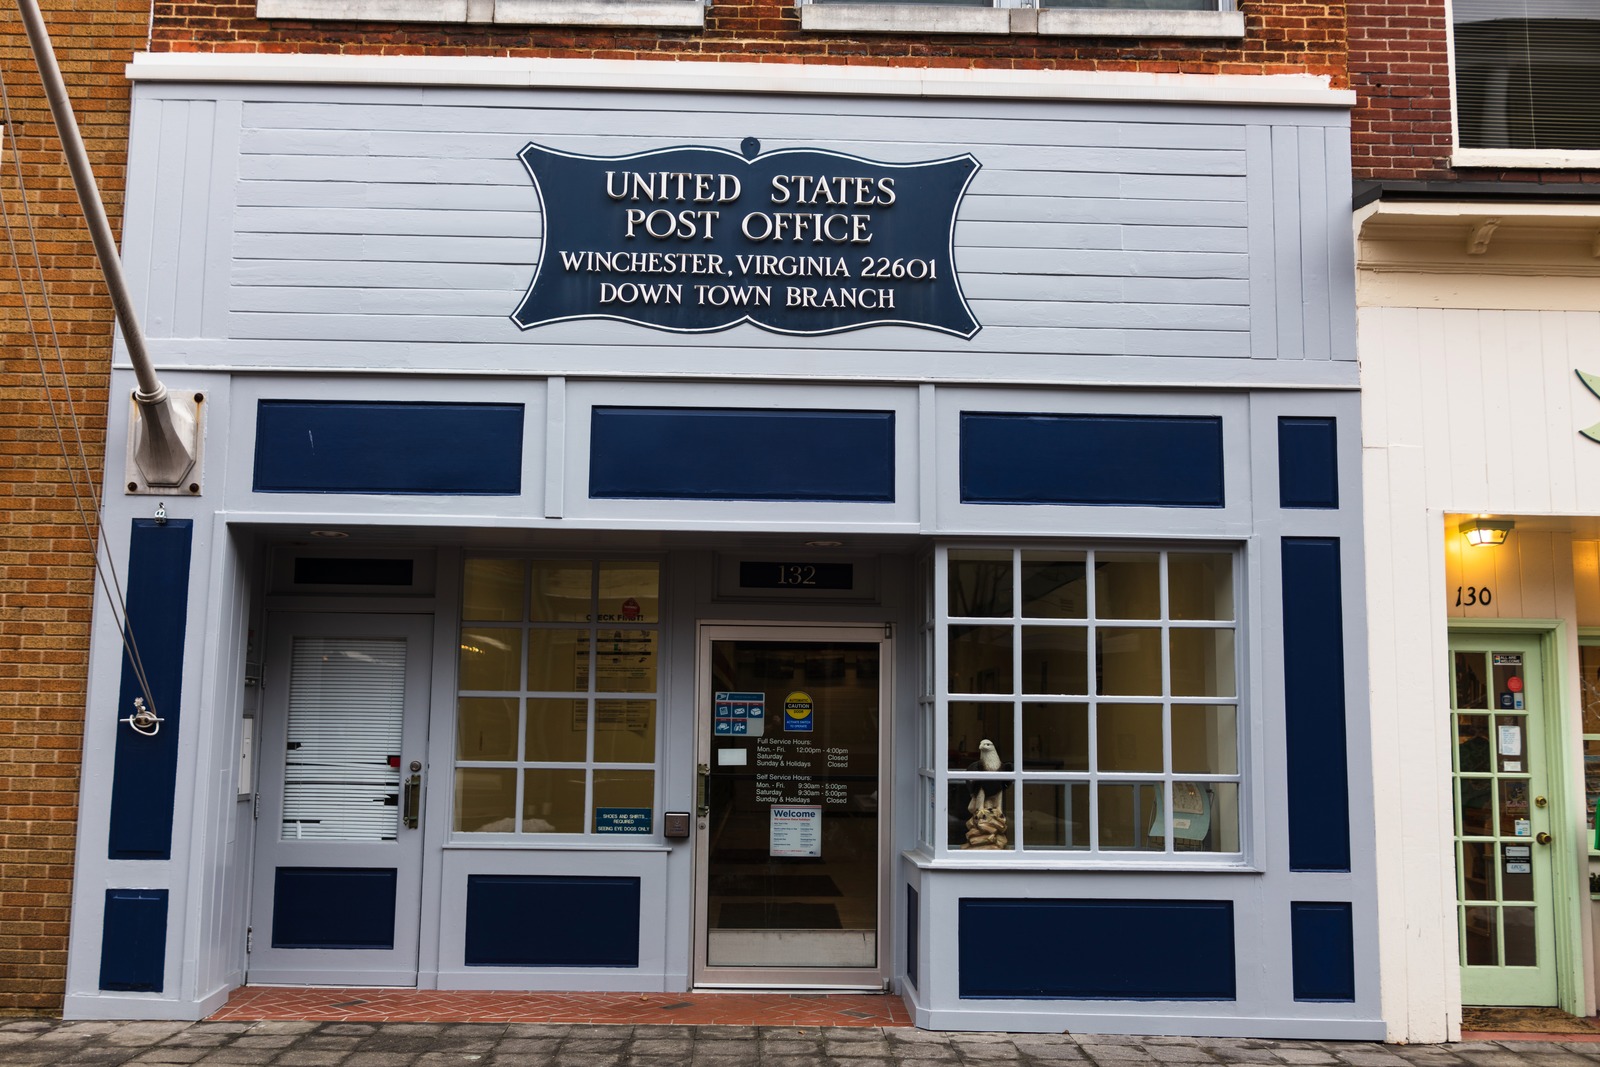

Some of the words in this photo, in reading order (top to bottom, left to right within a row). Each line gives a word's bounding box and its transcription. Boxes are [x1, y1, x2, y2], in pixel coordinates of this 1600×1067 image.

[604, 170, 741, 203] UNITED
[770, 174, 897, 206] STATES
[624, 208, 719, 240] POST
[741, 211, 873, 244] OFFICE
[558, 250, 733, 278] WINCHESTER,
[735, 254, 851, 278] VIRGINIA
[860, 256, 937, 281] 22601
[599, 282, 683, 305] DOWN
[694, 284, 772, 307] TOWN
[785, 286, 896, 310] BRANCH
[777, 565, 816, 585] 132
[1455, 586, 1492, 607] 130
[774, 810, 816, 818] Welcome
